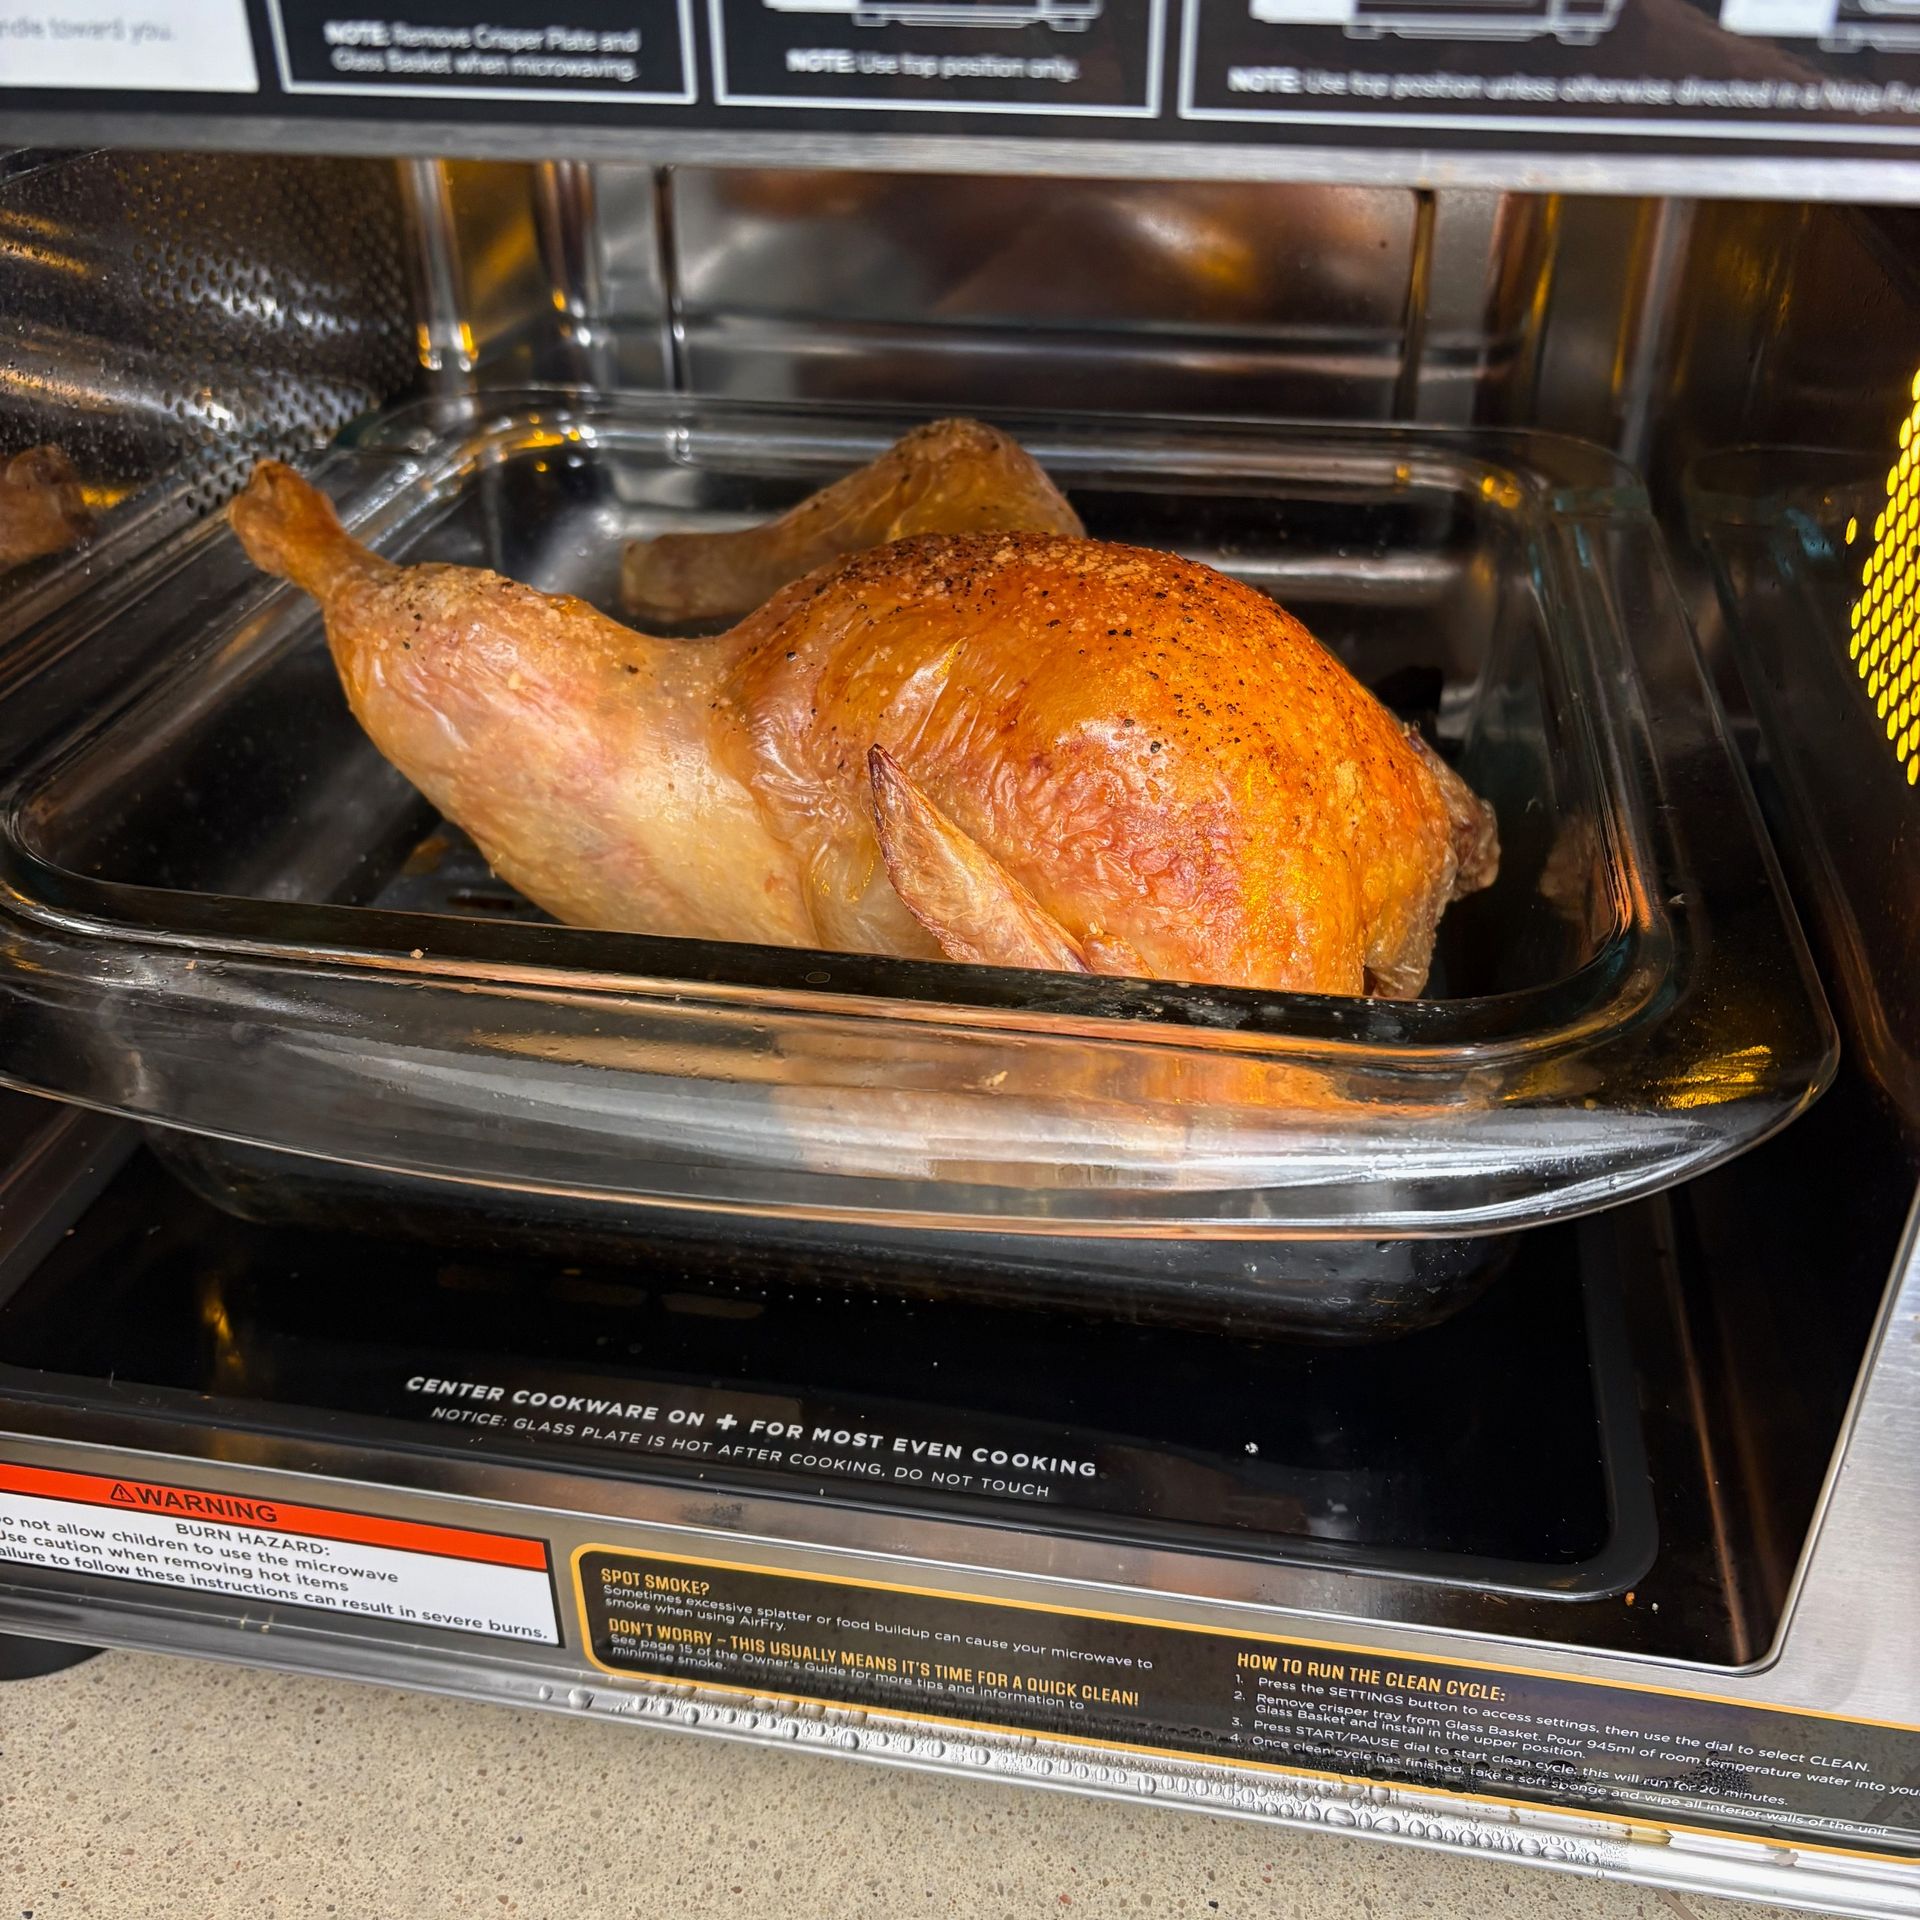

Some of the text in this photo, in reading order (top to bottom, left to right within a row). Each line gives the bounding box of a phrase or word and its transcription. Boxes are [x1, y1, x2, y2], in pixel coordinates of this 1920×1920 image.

[786, 49, 856, 73] NOTE:
[858, 51, 898, 74] Use
[901, 52, 938, 78] top
[940, 54, 1024, 79] position
[406, 1376, 1096, 1477] CENTER COOKWARE ON FOR MOST EVEN COOKING
[432, 1407, 1050, 1497] NOTICE: GLASS PLATE IS HOT AFTER DO NOT TOUCH
[135, 1487, 277, 1523] WARNING
[20, 1517, 399, 1583] not allow children to use the microwave
[34, 1537, 349, 1592] caution when removing hot items
[176, 1523, 331, 1556] BURN HAZARD:
[51, 1553, 548, 1639] to follow these instructions can result in severe burns.
[601, 1568, 710, 1596] SPOT SMOKE?
[605, 1598, 787, 1631] smoke when using AirFry.
[603, 1585, 1152, 1669] Sometimes excessive splatter or food buildup can cause your microwave to
[612, 1647, 727, 1670] minimise smoke.
[608, 1618, 1139, 1706] DON'T WORRY THIS USUALLY MEANS IT'S TIME FOR A QUICK CLEAN!
[610, 1634, 1084, 1710] See page 15 of the Owner's Guide for more tips and information to
[1237, 1653, 1506, 1702] HOW TO RUN THE CLEAN CYCLE:
[1234, 1691, 1886, 1792] 2. Remove crisper tray from Glass Basket. Pour 945ml of room temperature water into
[1256, 1705, 1586, 1759] Glass Basket and install in the upper position.
[1258, 1678, 1870, 1772] Press the SETTINGS button to access settings, then use the dial to select CLEAN.
[1253, 1736, 1640, 1800] Once clean cycle has take soft and
[1255, 1720, 1788, 1806] Press START/PAUSE dial to start clean this will minutes.
